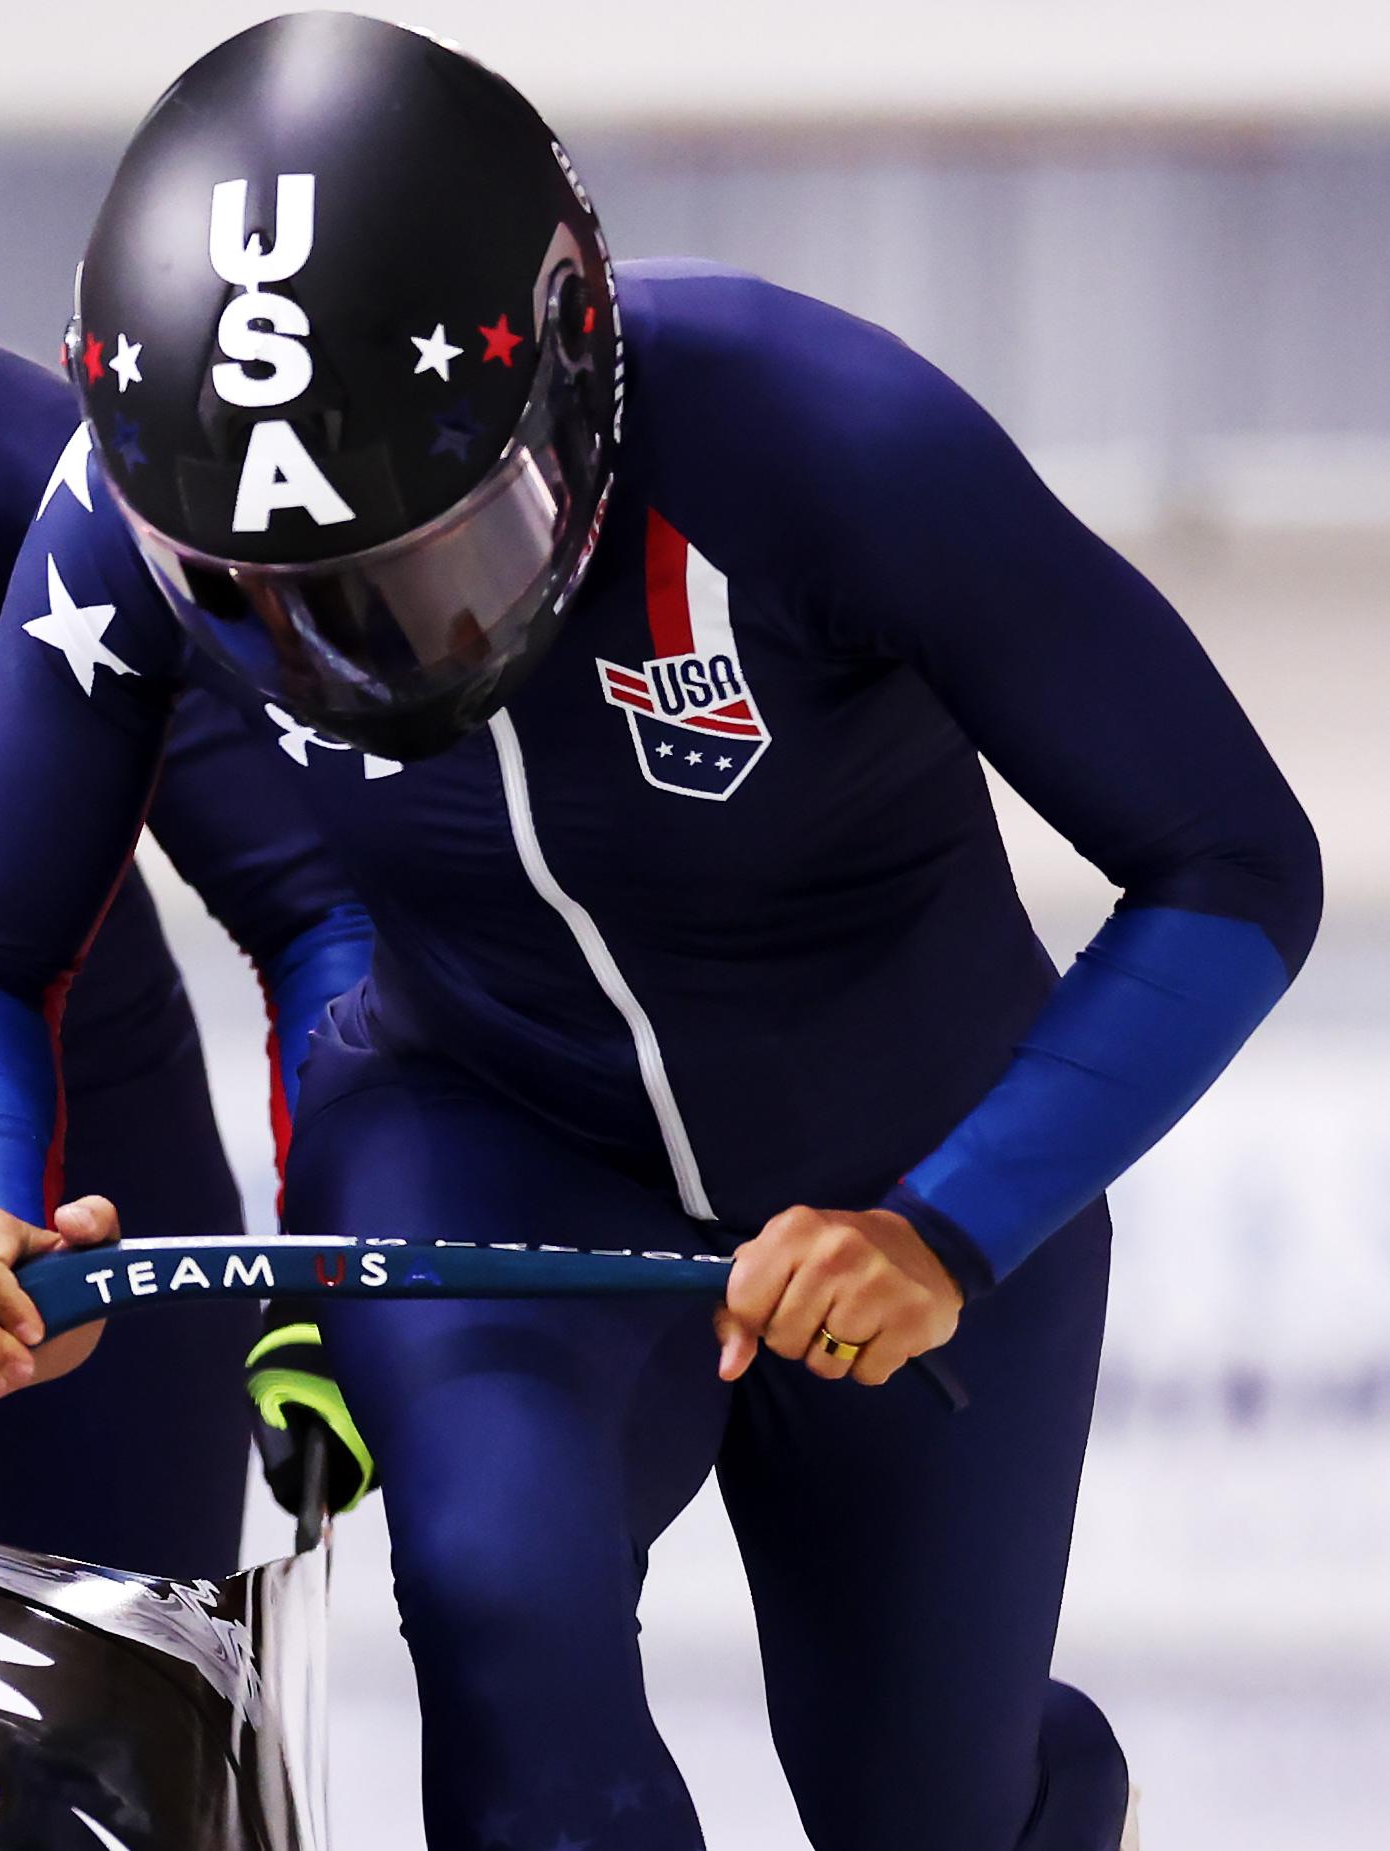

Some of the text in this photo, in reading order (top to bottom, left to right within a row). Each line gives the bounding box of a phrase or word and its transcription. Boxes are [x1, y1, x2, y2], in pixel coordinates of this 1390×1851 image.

[210, 173, 356, 533] USA
[650, 654, 743, 716] USA
[87, 1252, 442, 1305] TEAM USA
